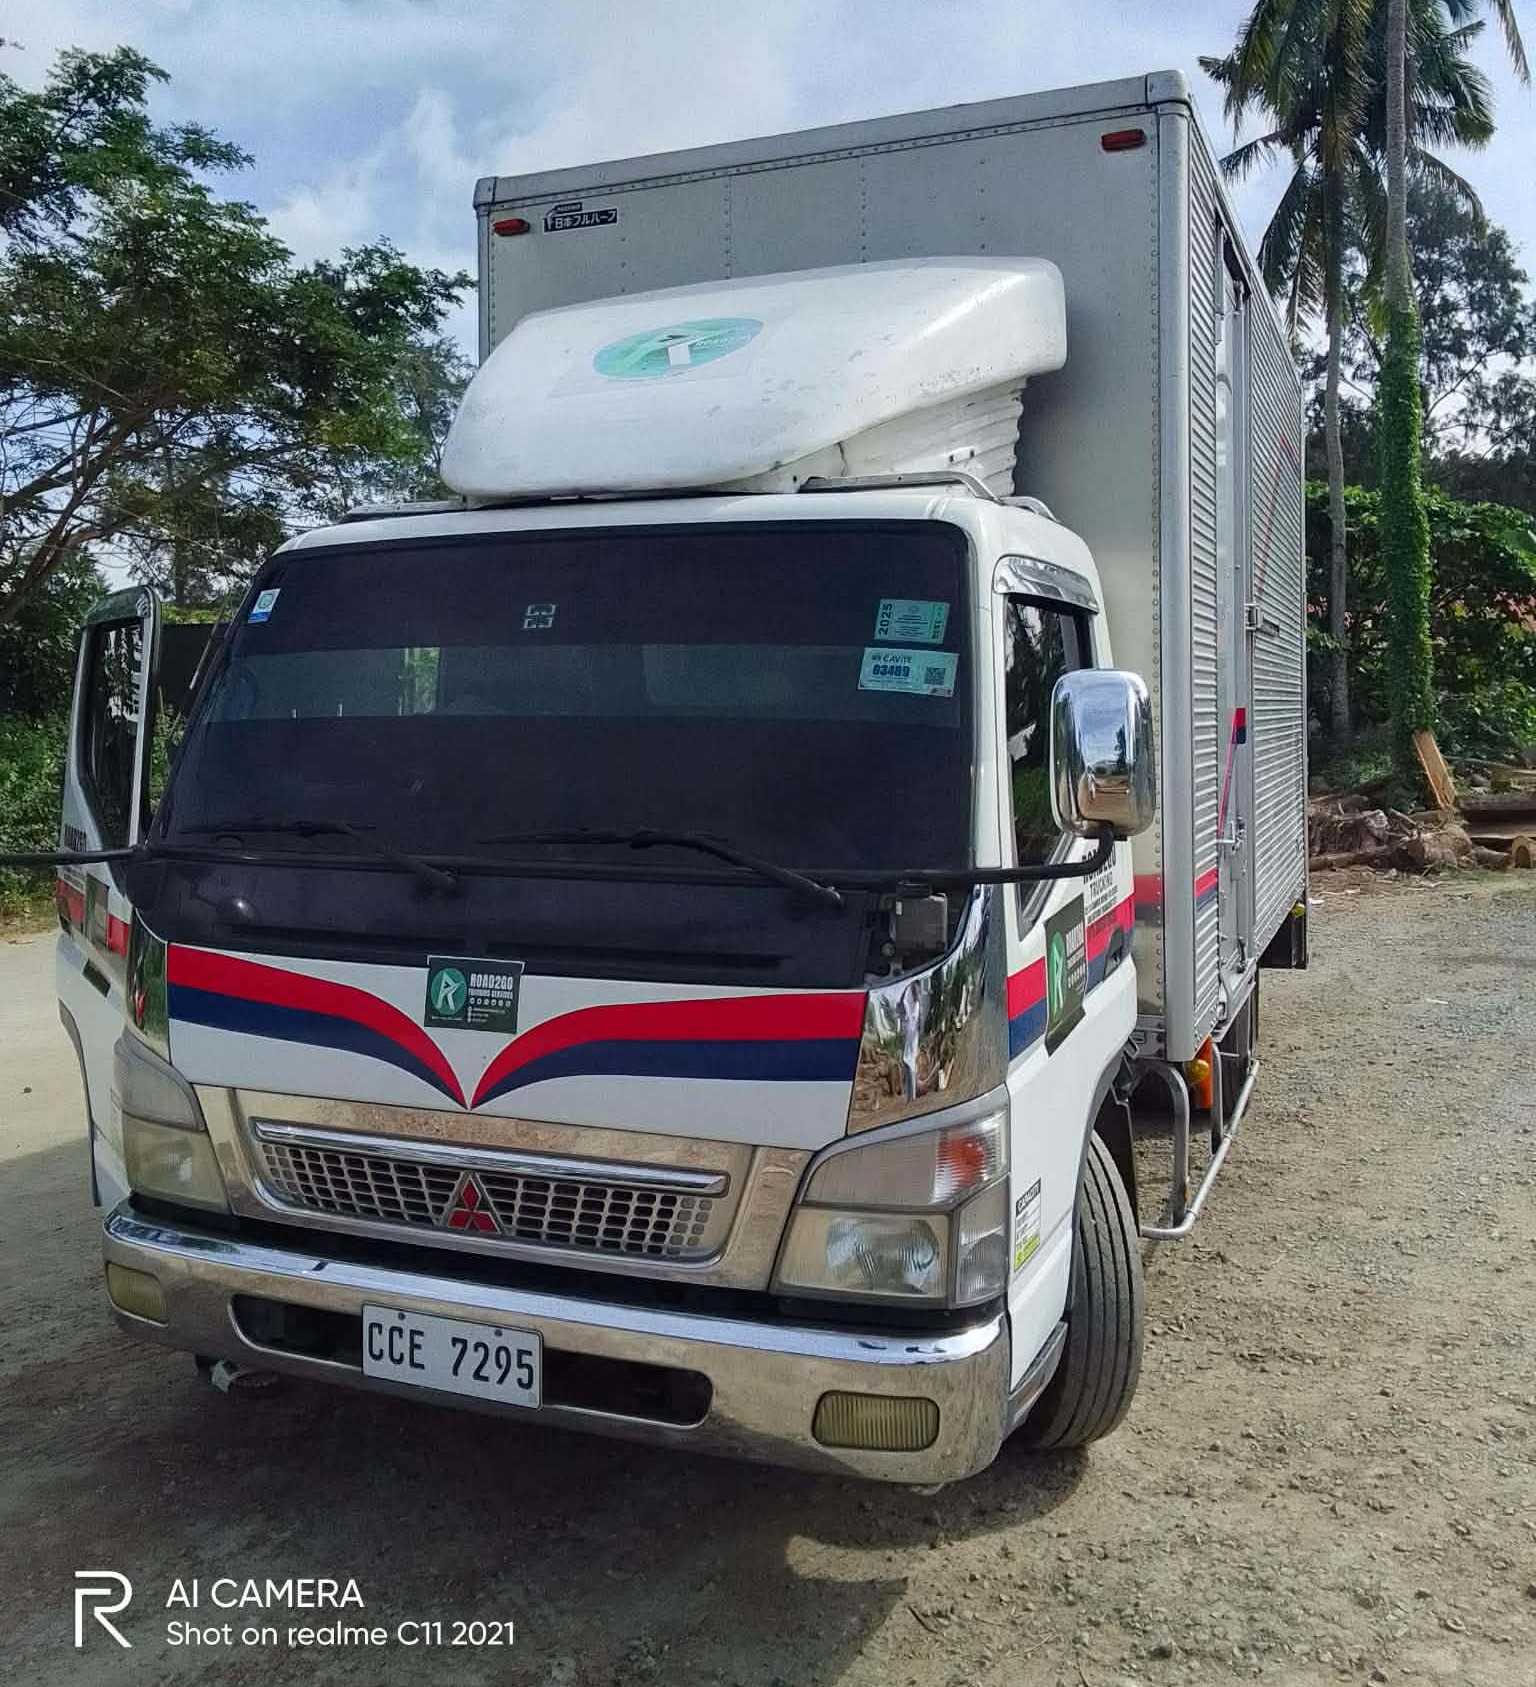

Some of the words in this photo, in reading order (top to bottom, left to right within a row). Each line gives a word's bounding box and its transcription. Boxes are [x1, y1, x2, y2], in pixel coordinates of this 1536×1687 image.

[878, 603, 894, 636] 2025
[883, 653, 913, 664] CAVITE
[470, 973, 514, 990] ROAD2GO
[368, 1322, 425, 1370] CCE
[451, 1337, 534, 1390] 7295
